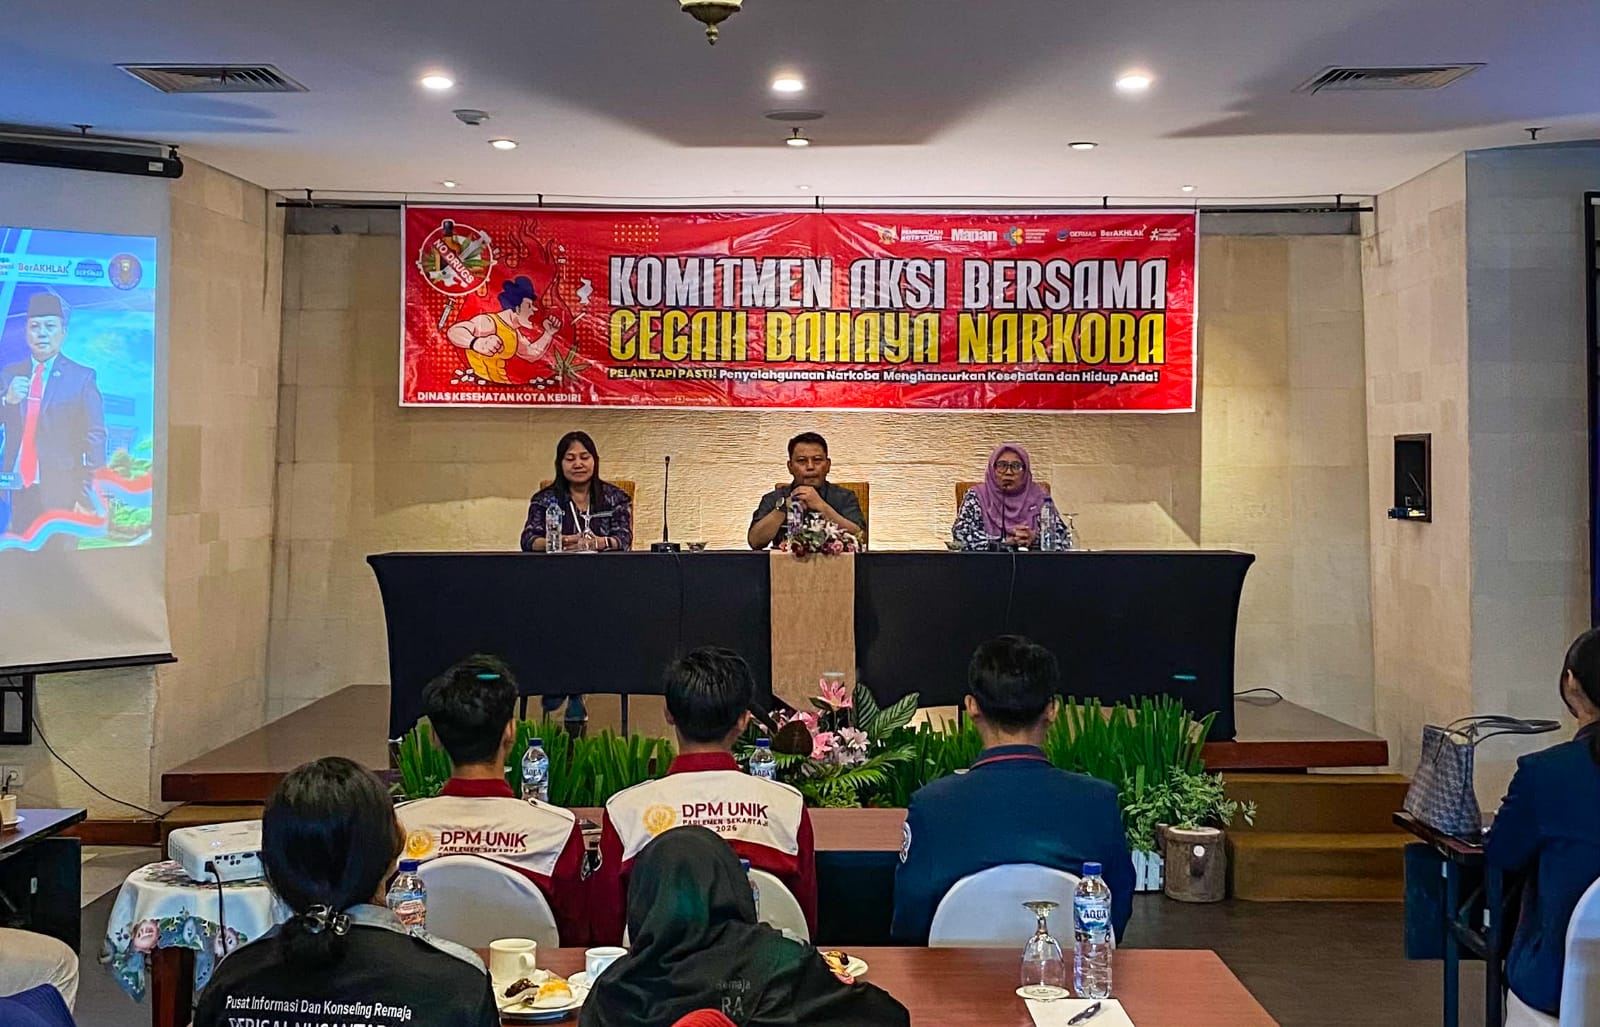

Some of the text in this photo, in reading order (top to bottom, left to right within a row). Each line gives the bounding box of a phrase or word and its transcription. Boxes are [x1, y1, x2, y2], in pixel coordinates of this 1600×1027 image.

[951, 228, 998, 241] Mapan
[1100, 229, 1144, 237] BerAKHLAK
[18, 262, 69, 274] BerAKHLAK
[433, 238, 475, 284] NO DRUGS
[609, 256, 1166, 309] KOMITMEN AKSI BERSAMA
[609, 309, 1165, 364] CEGAH BAHAYA NARKOBA
[610, 368, 647, 378] PELAN
[650, 369, 676, 378] TAPI
[678, 369, 717, 379] PASTI!
[719, 369, 825, 382] Penyalahgunaan
[826, 371, 880, 380] Narkoba
[883, 371, 985, 383] Menghancurkan
[1056, 371, 1080, 381] dan
[1082, 371, 1119, 384] Hidup
[1119, 371, 1159, 381] Anda!
[417, 391, 451, 400] DINAS
[452, 392, 515, 401] KESEHATAN
[516, 393, 545, 402] KOTA
[549, 393, 581, 403] KEDIRI
[682, 802, 768, 819] DPM UNIK
[716, 825, 737, 833] 2026
[440, 831, 528, 847] DPM UNIK
[1083, 909, 1107, 920] AQUA
[225, 995, 250, 1009] Pusat
[251, 996, 299, 1012] Informasi
[300, 1000, 321, 1014] Dan
[323, 1001, 372, 1018] Konseling
[373, 1003, 412, 1022] Remaja
